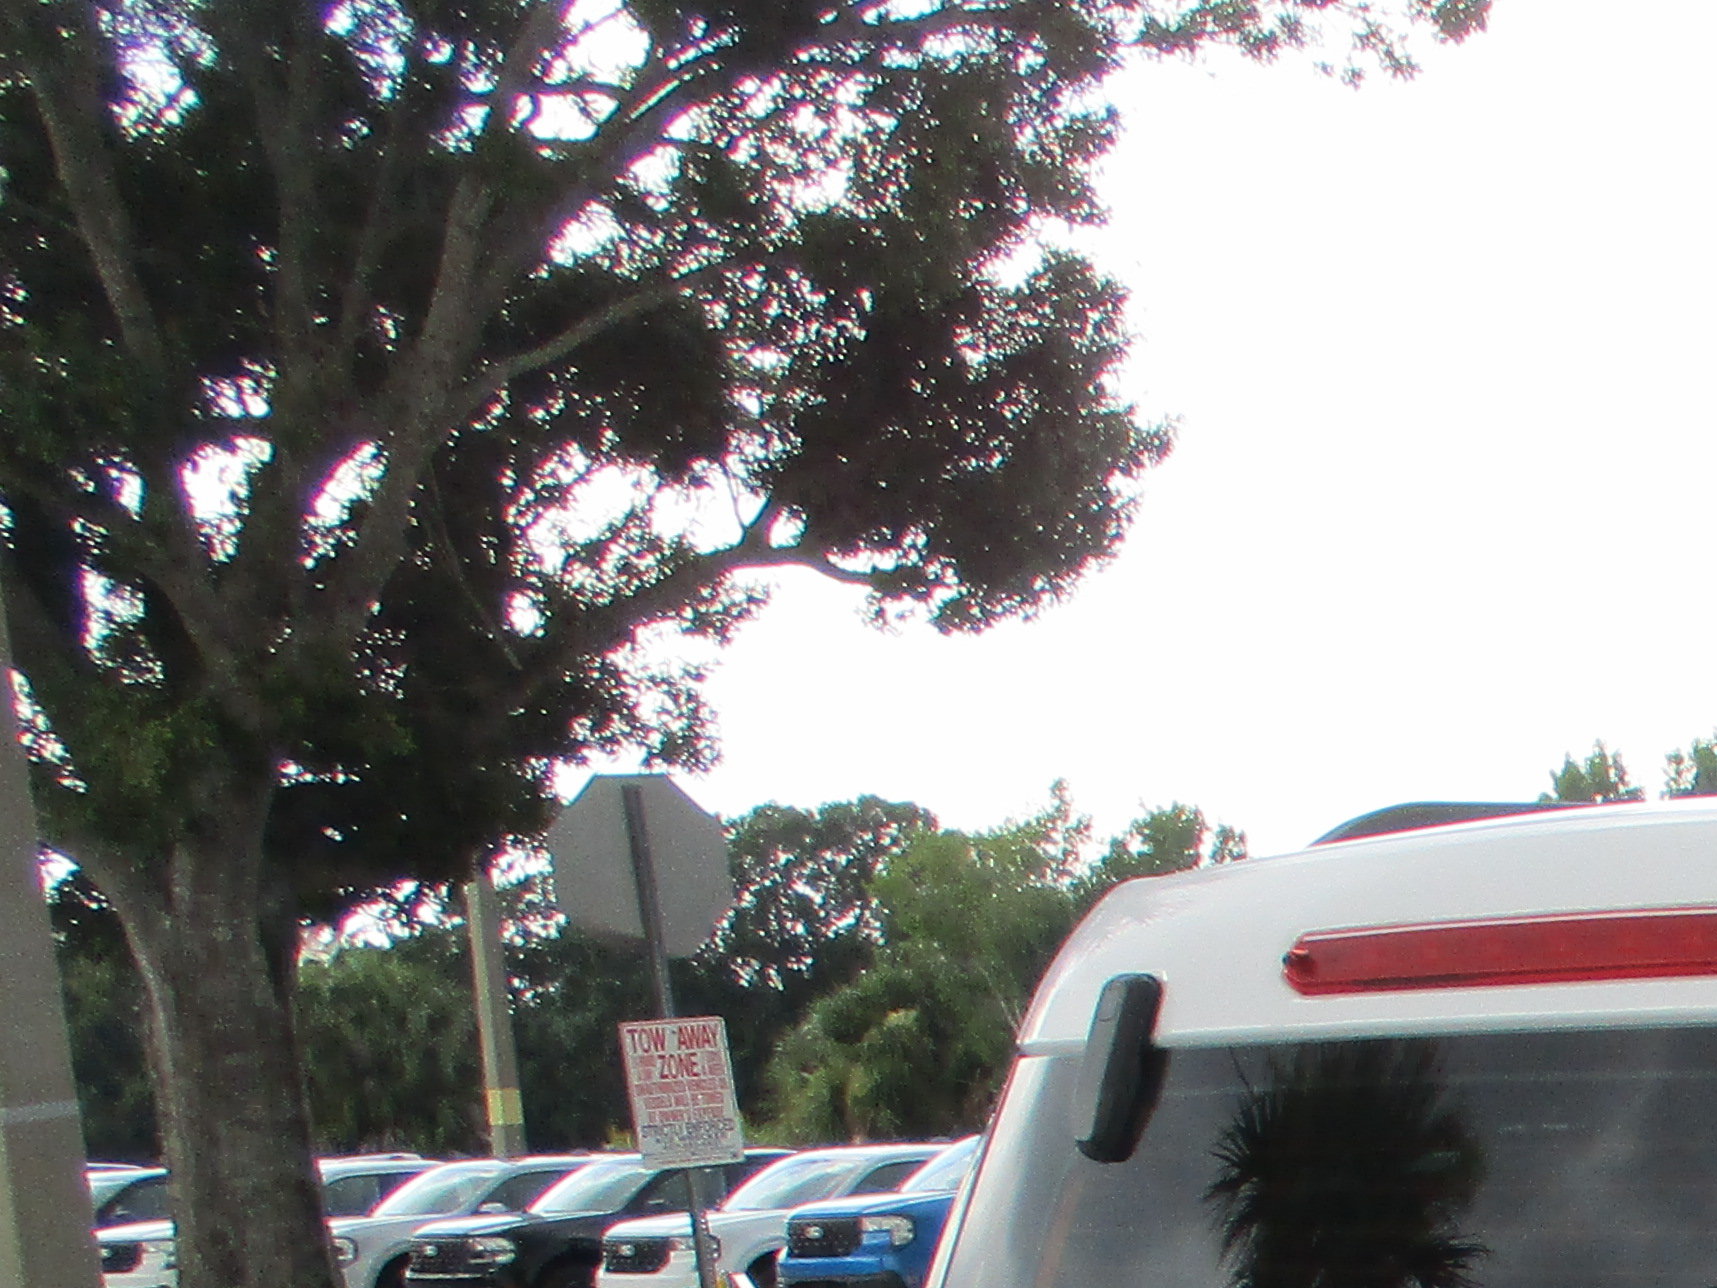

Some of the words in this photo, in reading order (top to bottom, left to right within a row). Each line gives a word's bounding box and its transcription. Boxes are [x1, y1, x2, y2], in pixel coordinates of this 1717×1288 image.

[626, 1027, 666, 1054] TOW
[678, 1023, 719, 1051] AWAY
[658, 1052, 700, 1080] ZONE
